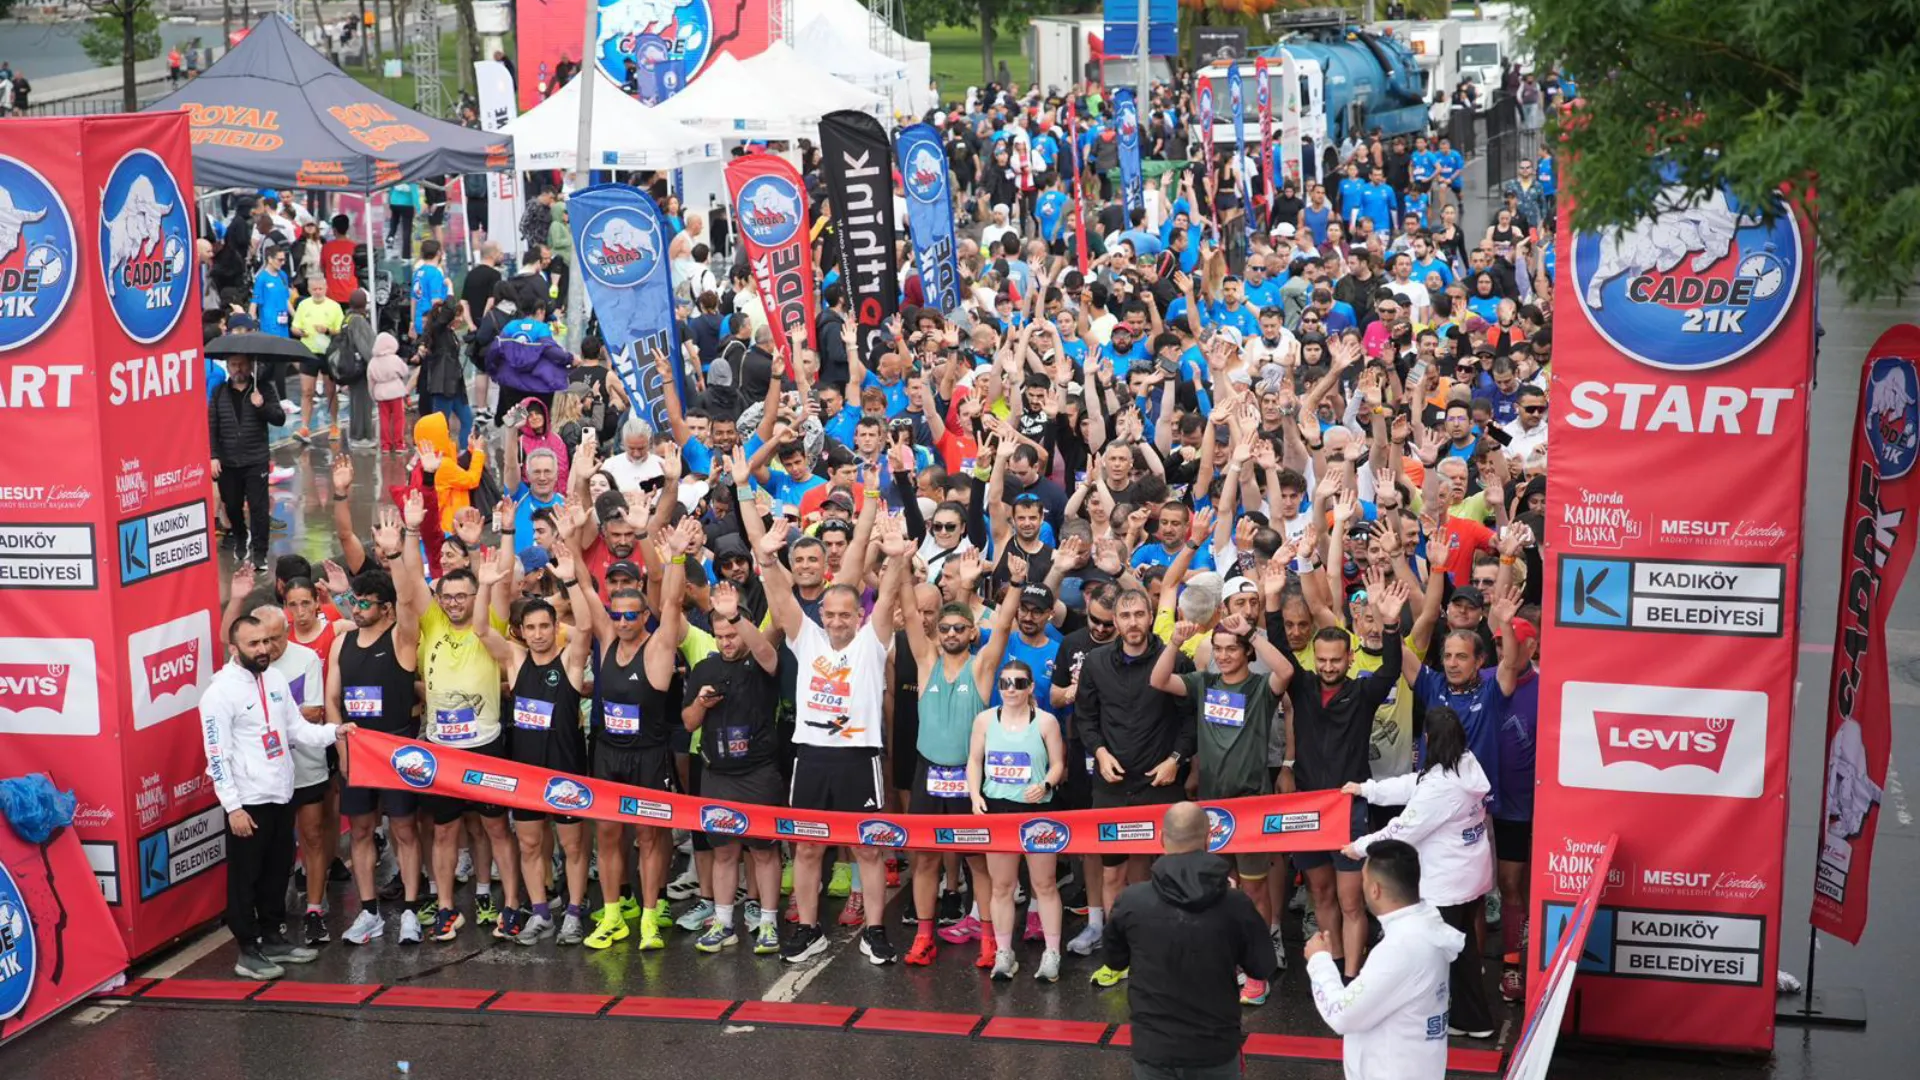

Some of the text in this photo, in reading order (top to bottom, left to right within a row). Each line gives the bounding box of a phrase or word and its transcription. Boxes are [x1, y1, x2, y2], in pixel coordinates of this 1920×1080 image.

[181, 103, 279, 130] ROYAL
[190, 128, 284, 151] FIELD
[331, 253, 352, 265] GO
[123, 260, 172, 288] CADDE
[145, 286, 172, 309] 21K
[1629, 275, 1754, 307] CADDE
[1681, 308, 1747, 333] 21K
[0, 365, 83, 408] RT
[109, 348, 197, 406] START
[1564, 381, 1795, 435] START
[154, 469, 182, 488] MESUT
[1579, 488, 1624, 506] Sporda
[153, 513, 190, 536] KADIKÖY
[1564, 504, 1631, 527] KADIKÖY
[1575, 526, 1617, 545] BAŞKA
[1661, 520, 1730, 536] MESUT
[155, 538, 203, 567] BELEDİYESİ
[1649, 570, 1739, 590] KADIKÖY
[1646, 606, 1764, 627] BELEDİYESİ
[349, 701, 375, 710] 1073
[812, 693, 843, 706] 4704
[518, 712, 545, 725] 2945
[1209, 705, 1237, 718] 2477
[441, 724, 469, 734] 1254
[606, 717, 632, 728] 1325
[730, 741, 749, 751] 20
[994, 767, 1025, 777] 1207
[174, 775, 201, 798] MESUT
[933, 781, 965, 792] 2295
[174, 819, 209, 847] KADIKÖY
[174, 842, 222, 877] BELEDİYESİ
[1549, 852, 1600, 873] KADIK
[1559, 876, 1593, 893] BAŞK
[1643, 870, 1711, 887] MESUT
[1631, 920, 1719, 940] KADIKÖY
[1629, 953, 1745, 976] BELEDİYESİ
